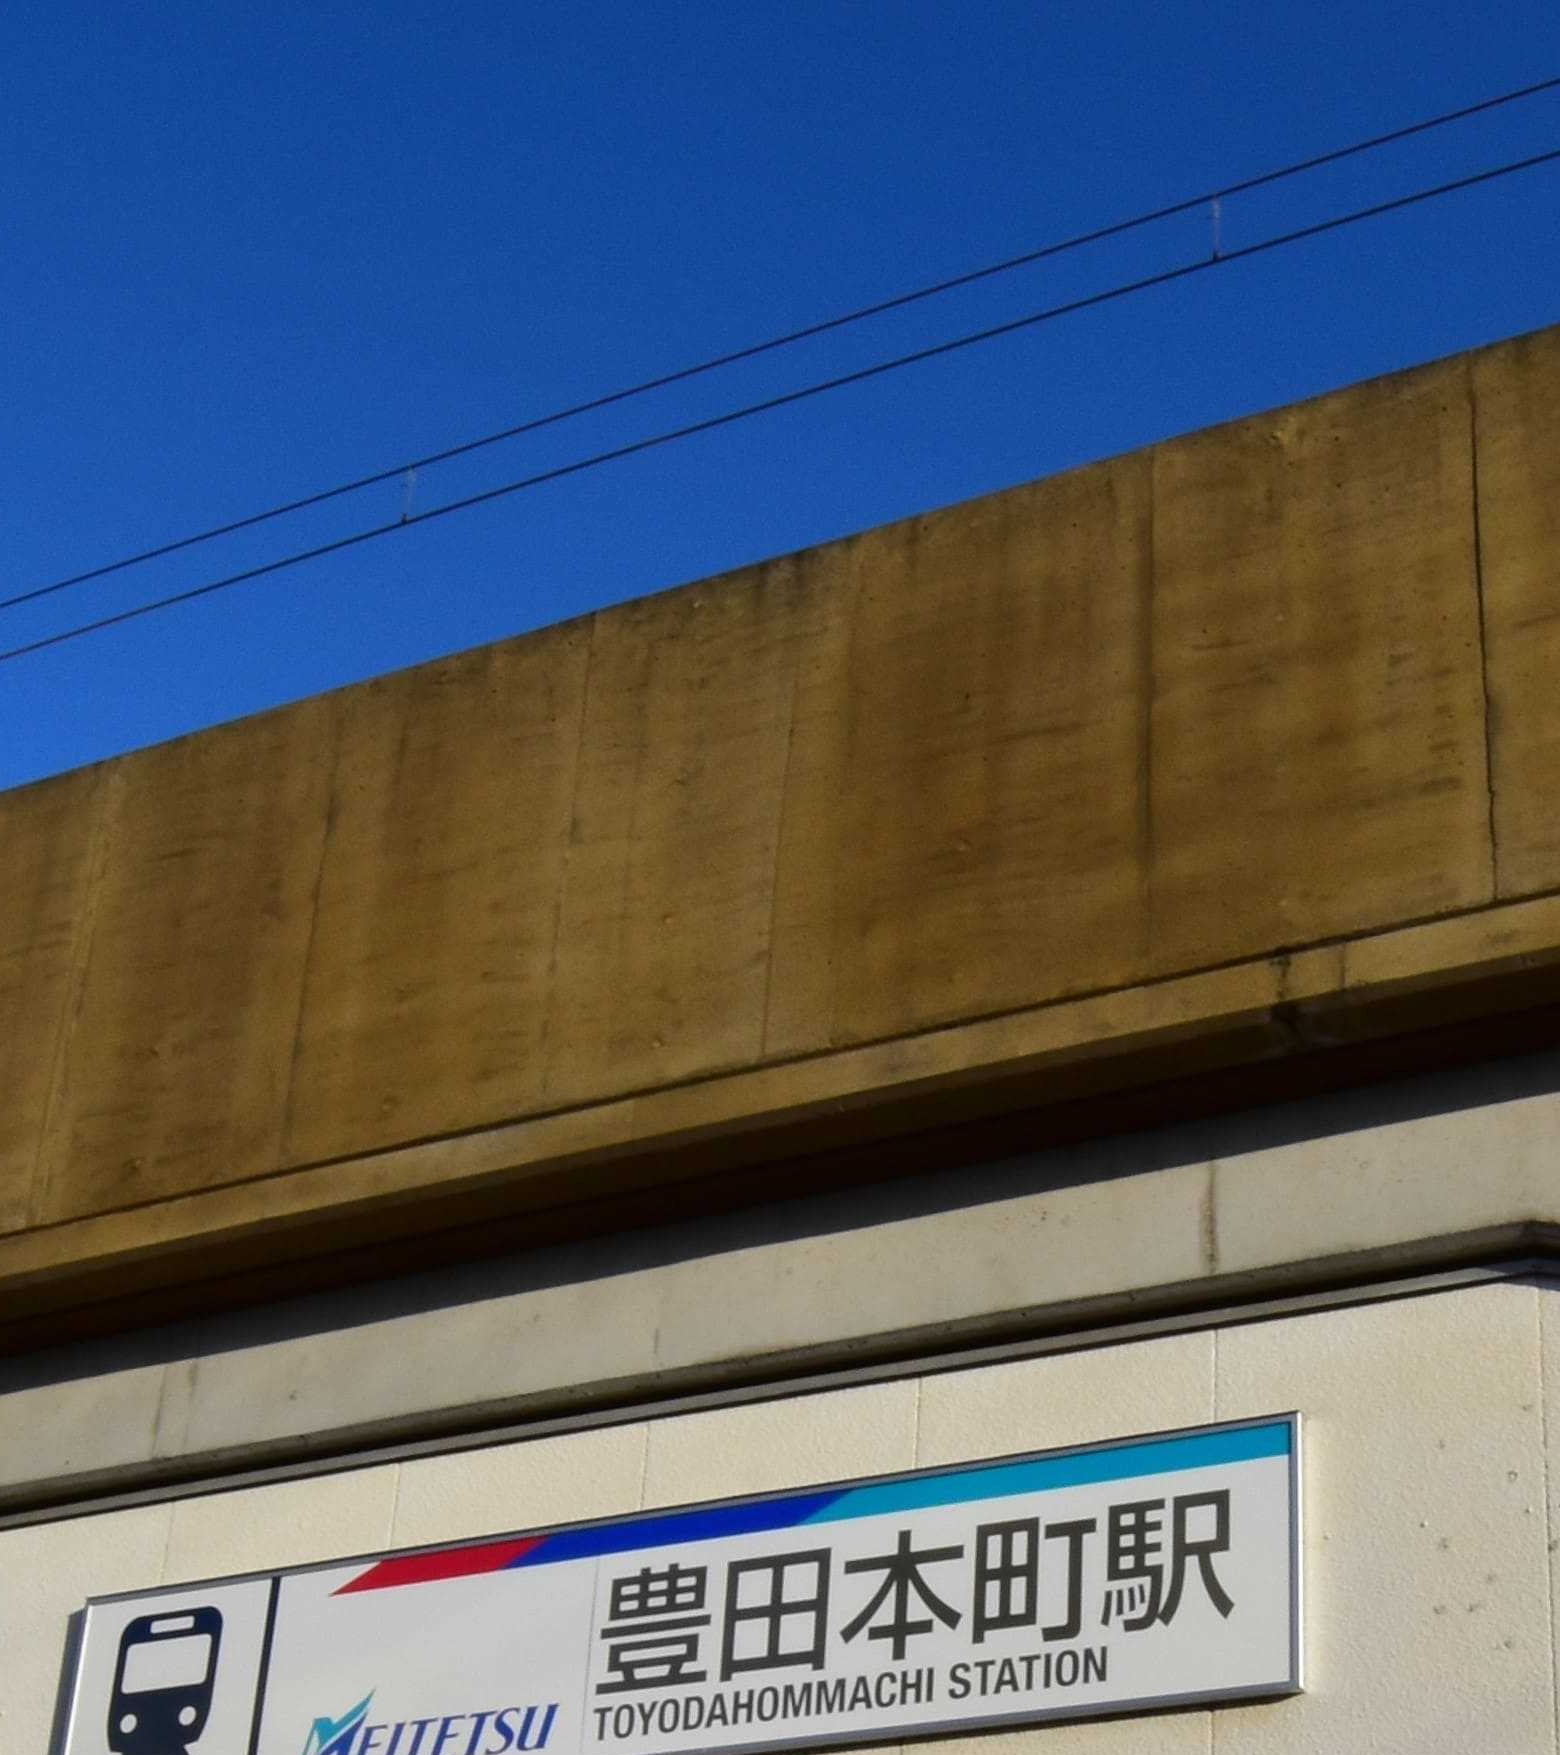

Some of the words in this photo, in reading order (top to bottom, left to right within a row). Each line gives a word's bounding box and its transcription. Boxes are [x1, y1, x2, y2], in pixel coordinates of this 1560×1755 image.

[595, 1489, 1235, 1697] 豊田本町駅
[593, 1667, 936, 1744] TOYODAHOMMACHI
[947, 1645, 1109, 1702] STATION
